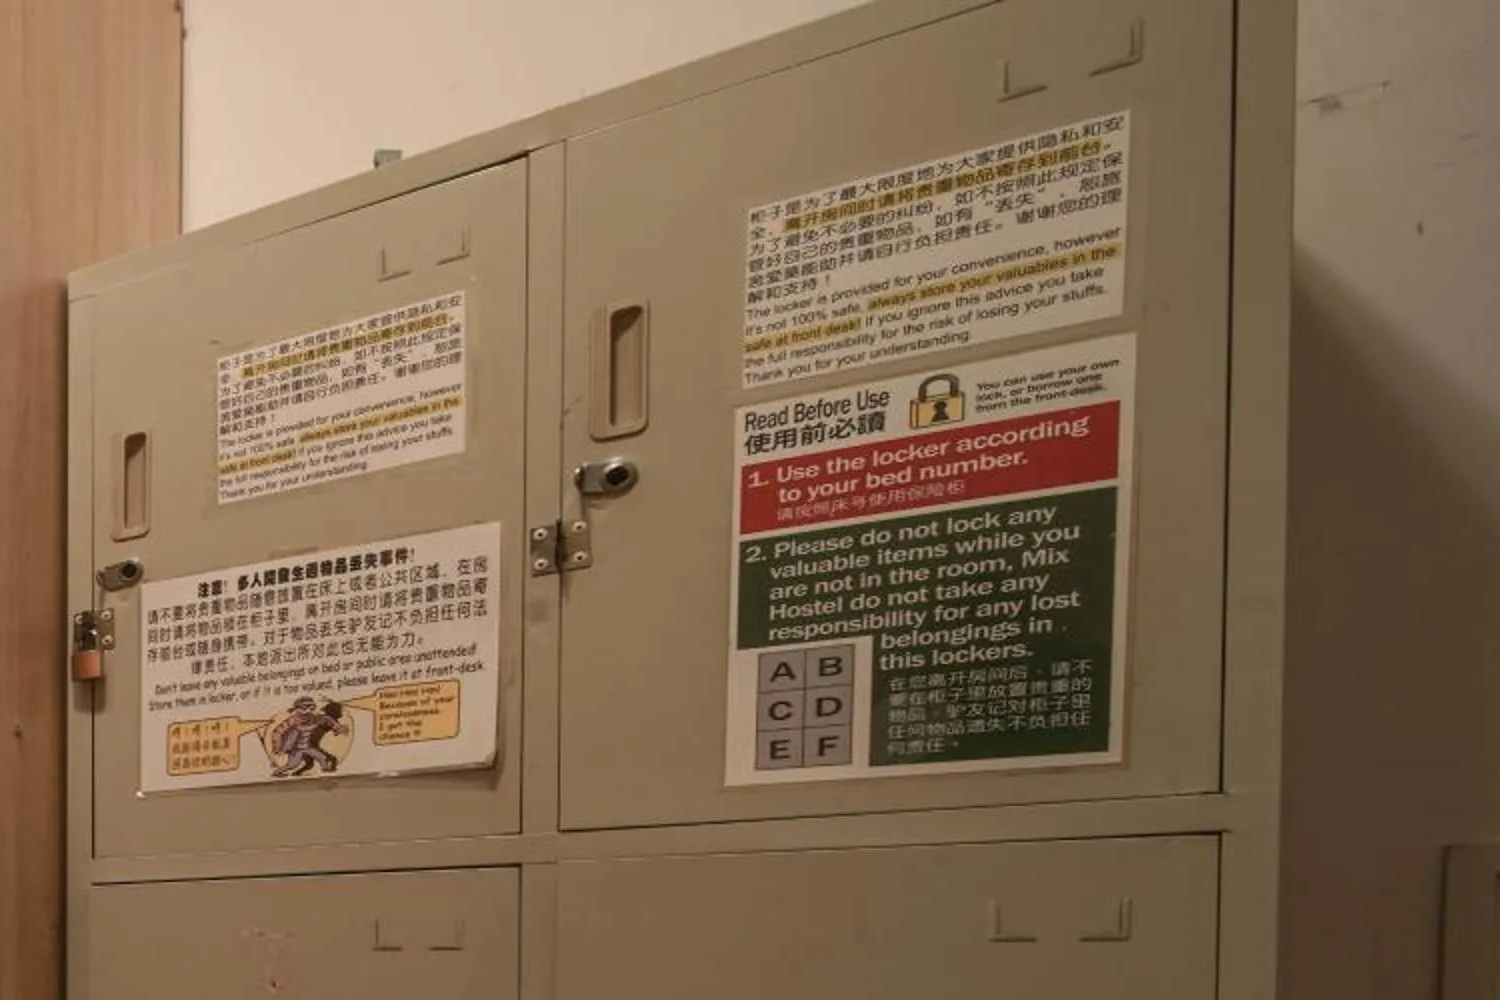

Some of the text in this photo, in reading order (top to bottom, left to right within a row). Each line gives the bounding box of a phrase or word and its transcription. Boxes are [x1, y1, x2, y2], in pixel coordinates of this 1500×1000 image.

[746, 307, 771, 319] The
[773, 297, 813, 314] locker
[816, 294, 827, 304] is
[831, 278, 890, 304] provided
[893, 275, 913, 287] for
[915, 267, 948, 285] your
[1053, 227, 1121, 251] however
[765, 317, 787, 332] not
[920, 282, 956, 299] store
[959, 274, 992, 292] your
[996, 257, 1068, 282] valuables
[1072, 253, 1086, 265] in
[1090, 246, 1117, 261] the
[743, 357, 765, 368] the
[789, 332, 877, 359] responsibility
[880, 328, 899, 340] for
[902, 323, 925, 336] the
[928, 315, 954, 330] risk
[957, 310, 973, 325] of
[975, 303, 1019, 320] losing
[1023, 294, 1058, 313] your
[744, 338, 772, 353] safe
[791, 326, 821, 342] front
[877, 311, 903, 327] you
[906, 301, 951, 320] ignore
[955, 294, 981, 308] this
[985, 282, 1034, 302] advice
[1037, 275, 1066, 293] you
[1070, 266, 1104, 283] take
[745, 368, 784, 384] Thank
[787, 363, 811, 378] you
[814, 358, 833, 371] for
[835, 351, 866, 369] your
[744, 389, 890, 432] Read Before Use
[748, 415, 1090, 488] 1. Use the locker according
[778, 451, 1028, 503] to your bed number.
[745, 506, 1056, 563] 2. Please do not lock any
[769, 525, 1080, 579] valuable items while you
[769, 583, 808, 600] are
[814, 575, 853, 595] not
[859, 572, 882, 588] in
[888, 567, 930, 585] the
[1021, 547, 1069, 568] Mix
[769, 573, 1049, 621] Hostel do not take any
[768, 590, 1080, 641] responsibility for any lost
[1029, 616, 1052, 634] in
[769, 660, 797, 683] A
[818, 656, 843, 677] B
[879, 643, 1032, 671] this lockers.
[767, 698, 793, 722] C
[815, 696, 843, 717] D
[768, 738, 790, 760] E
[817, 735, 839, 757] F
